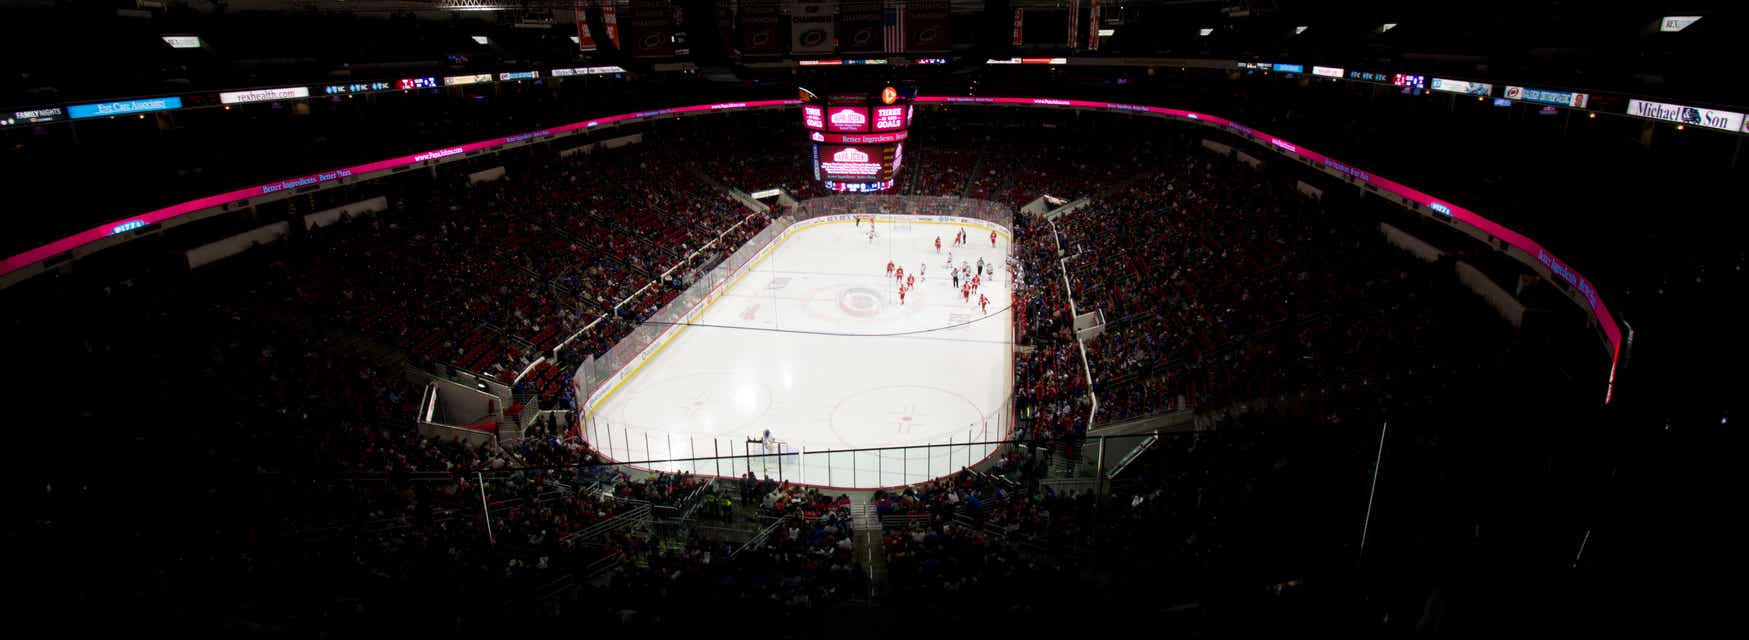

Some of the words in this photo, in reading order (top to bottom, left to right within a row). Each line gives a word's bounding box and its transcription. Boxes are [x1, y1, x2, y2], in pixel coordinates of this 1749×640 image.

[237, 90, 295, 102] rexhealth.com
[16, 109, 39, 118] FAMILY
[39, 108, 62, 116] NIGHTS
[878, 108, 902, 116] THREE
[1636, 101, 1681, 120] Michael
[1704, 110, 1729, 128] Son
[877, 120, 901, 128] GOALS
[262, 183, 282, 194] Better
